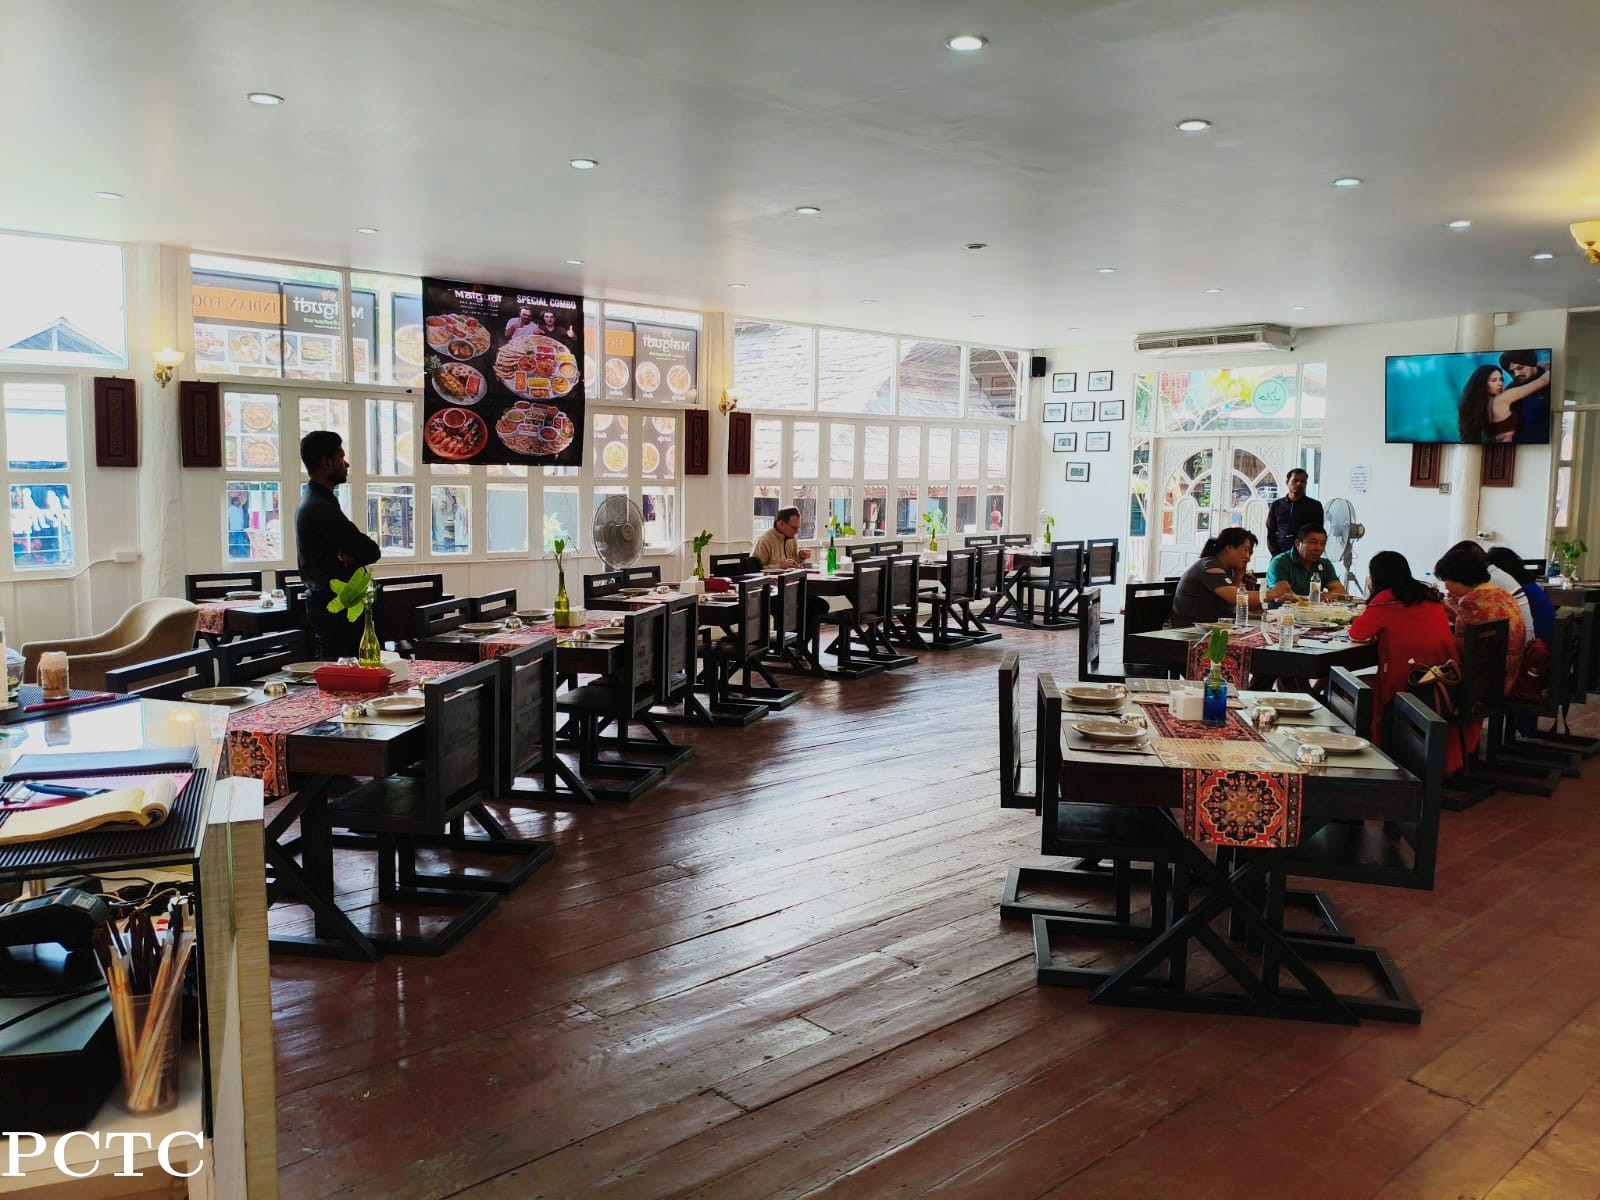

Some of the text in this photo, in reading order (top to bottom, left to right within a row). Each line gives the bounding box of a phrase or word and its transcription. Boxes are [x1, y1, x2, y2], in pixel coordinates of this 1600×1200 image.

[454, 290, 502, 302] Malgudi
[516, 294, 577, 310] SPECIAL COMBO
